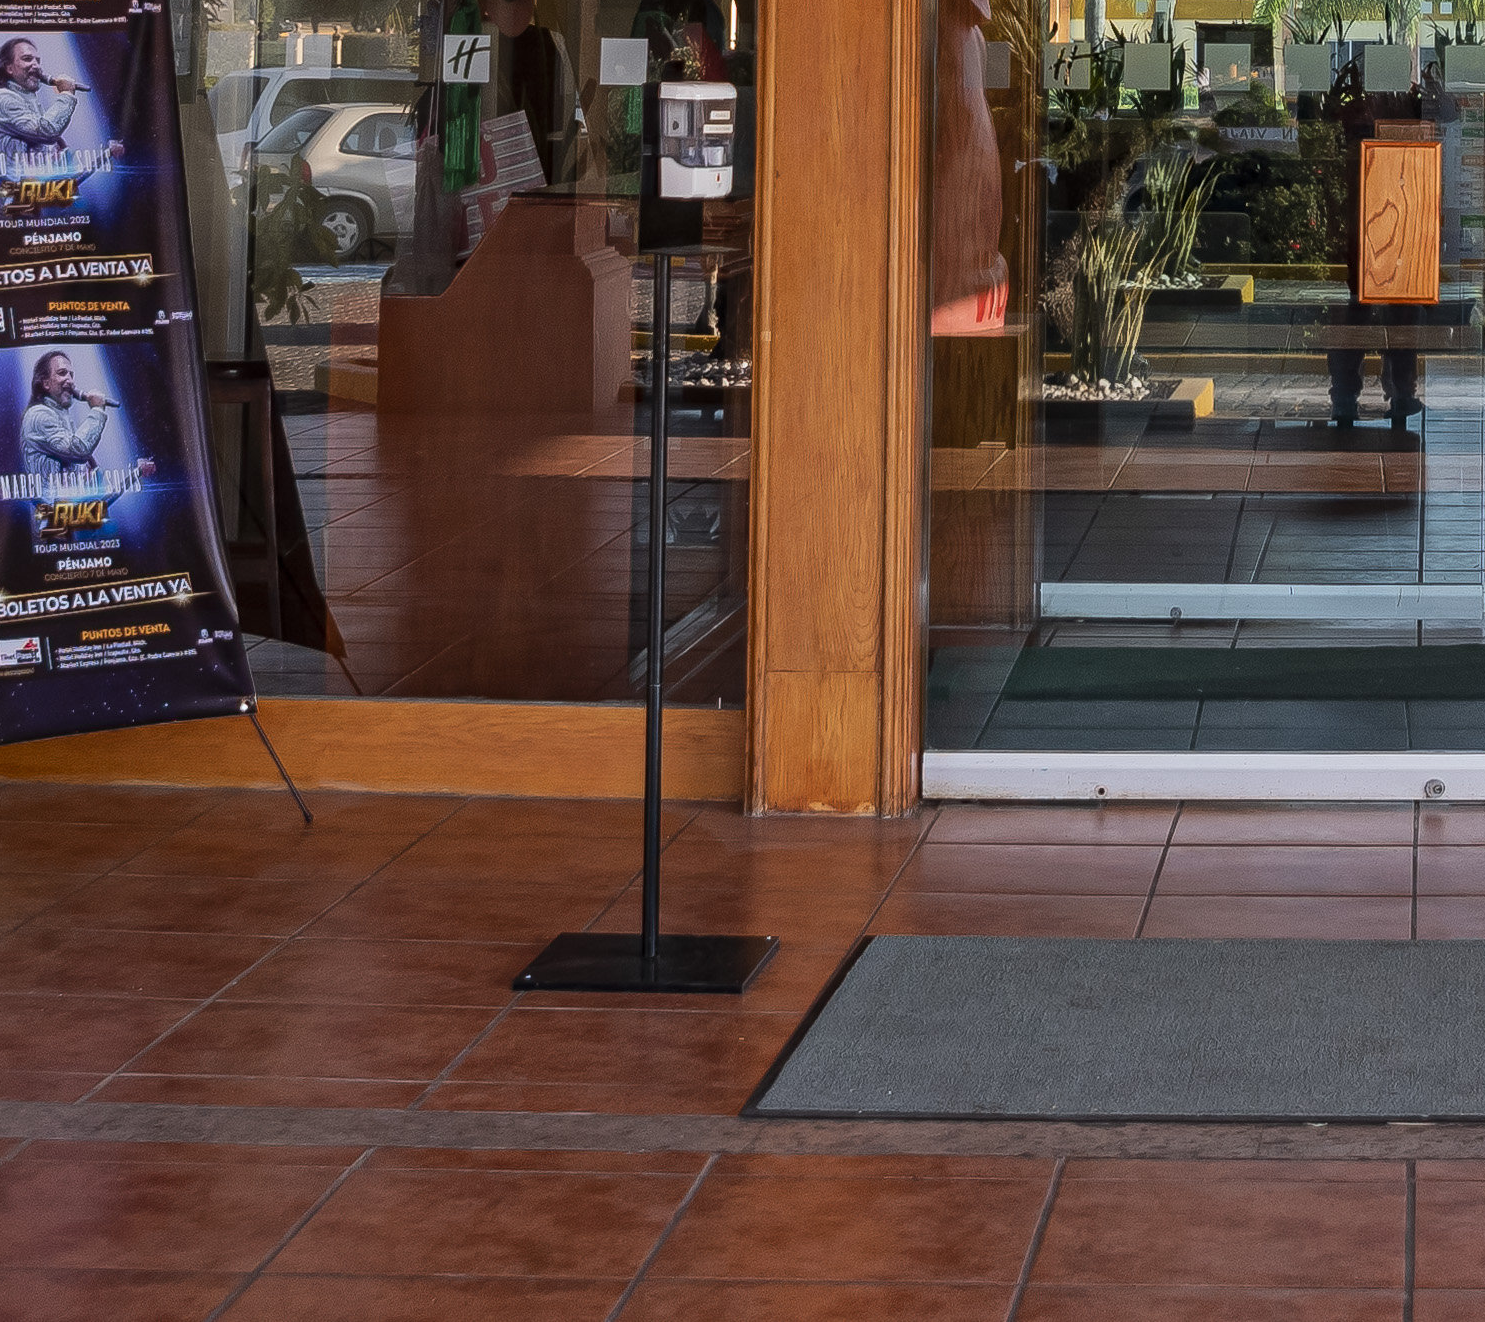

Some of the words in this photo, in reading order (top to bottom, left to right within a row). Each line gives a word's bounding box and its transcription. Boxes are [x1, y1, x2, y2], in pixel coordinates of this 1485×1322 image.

[74, 144, 112, 173] SOLÍS
[0, 220, 24, 228] TOUR
[26, 218, 68, 228] MUNDIAL
[70, 215, 90, 225] 2023
[24, 232, 81, 246] PÉNJAMO
[9, 246, 58, 255] CONCIERTO
[39, 267, 53, 281] A
[55, 263, 78, 279] LA
[78, 260, 129, 276] VENTA
[128, 259, 152, 273] YA
[49, 301, 86, 311] PUNTOS
[87, 301, 99, 310] DE
[100, 301, 131, 311] VENTA
[0, 473, 43, 499] MARCO
[105, 463, 142, 494] SOLÍS
[35, 544, 57, 554] TOUR
[59, 542, 100, 552] MUNDIAL
[101, 539, 120, 549] 2023
[57, 556, 112, 571] PÉNJAMO
[44, 570, 91, 581] CONCIERTO
[96, 569, 106, 577] DE
[71, 593, 86, 608] A
[88, 589, 110, 606] LA
[110, 582, 167, 602] VENTA
[167, 577, 192, 594] YA
[82, 628, 123, 641] PUNTOS
[124, 626, 137, 636] DE
[139, 623, 171, 635] VENTA
